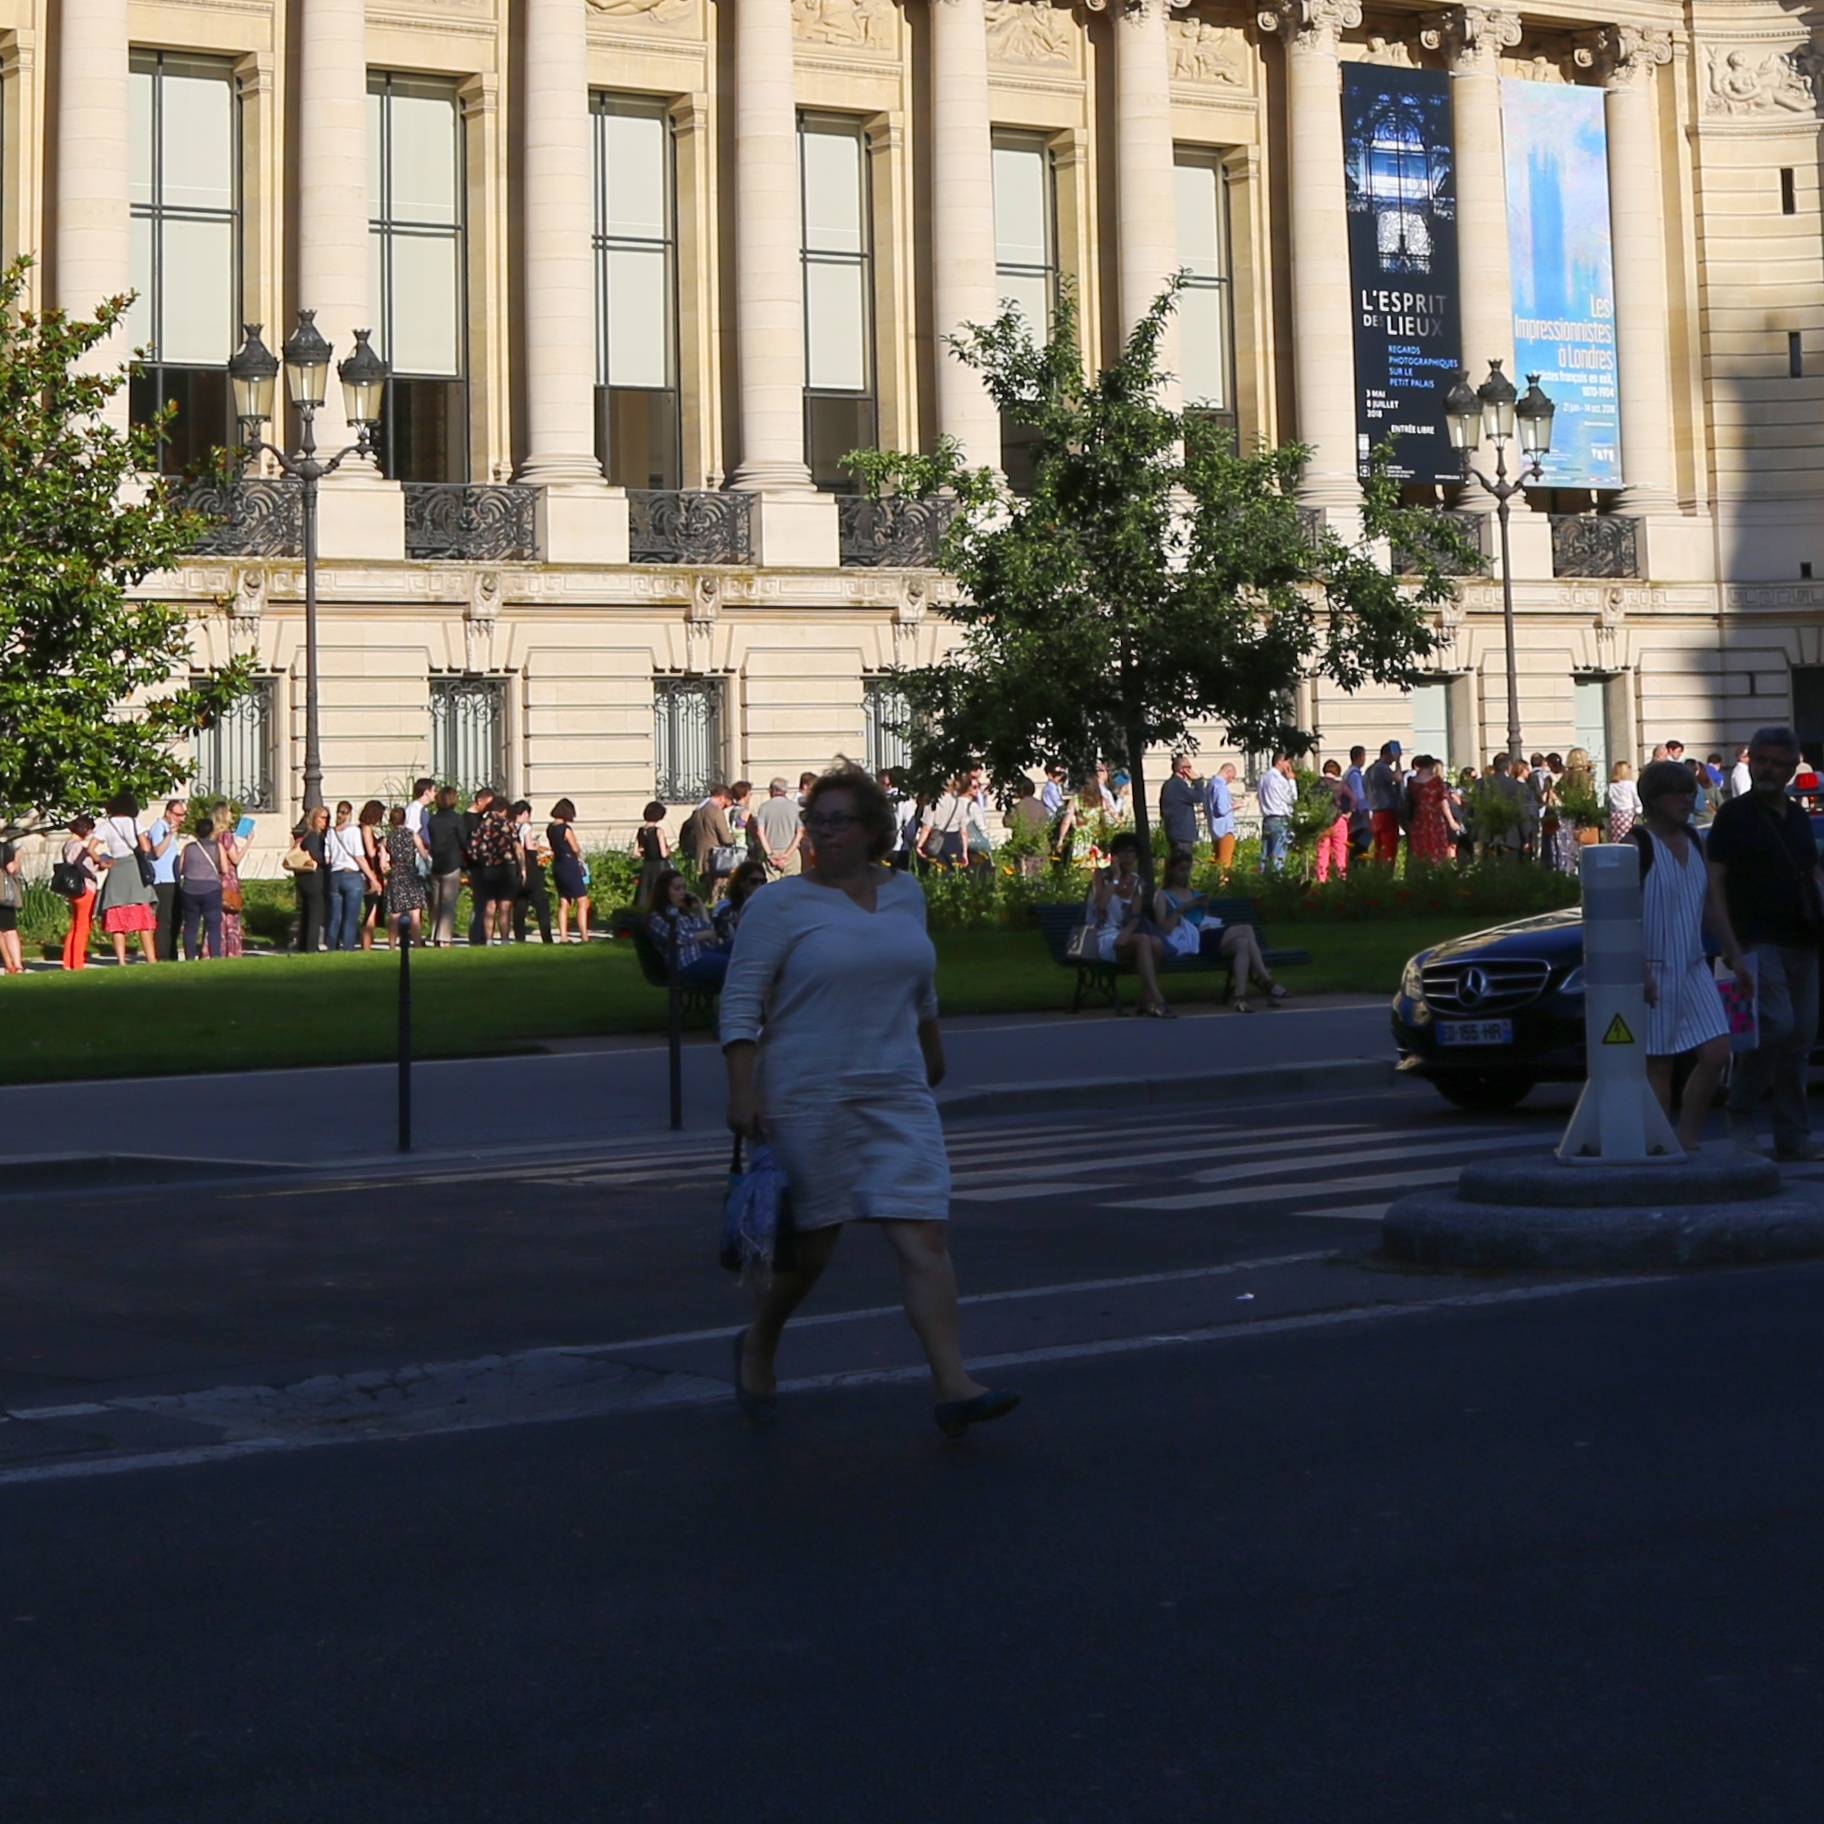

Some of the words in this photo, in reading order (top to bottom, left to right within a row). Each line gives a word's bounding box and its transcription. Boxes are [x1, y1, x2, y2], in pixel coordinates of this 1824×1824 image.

[1362, 289, 1447, 314] L'ESPRIT
[1590, 293, 1612, 318] Les
[1386, 314, 1445, 337] LIEUX
[1514, 313, 1613, 345] Impressionnistes
[1387, 344, 1422, 355] REGARDS
[1388, 355, 1459, 370] PHOTOGRAPHIQUES
[1567, 343, 1614, 370] Londres
[1388, 366, 1403, 376] SUR
[1389, 377, 1410, 387] PETIT
[1410, 378, 1435, 389] PALAIS
[1371, 389, 1386, 398] MAI
[1372, 399, 1400, 409] JUILLET
[1390, 423, 1417, 434] ENTRÉE
